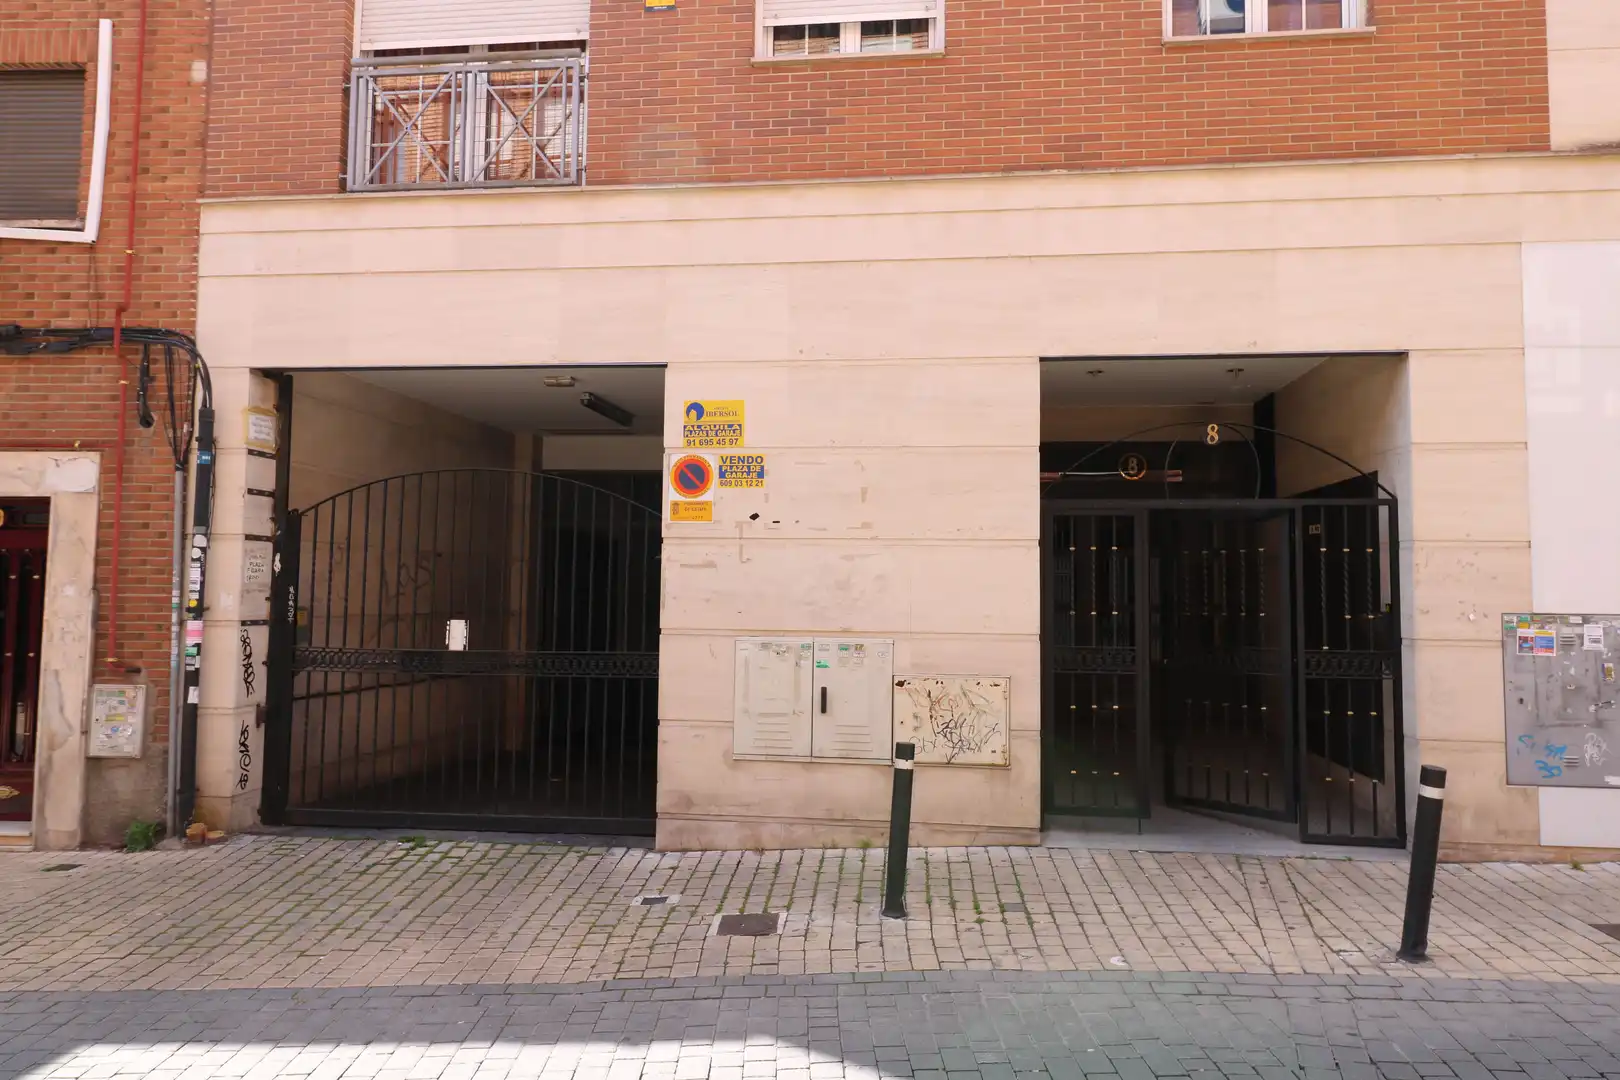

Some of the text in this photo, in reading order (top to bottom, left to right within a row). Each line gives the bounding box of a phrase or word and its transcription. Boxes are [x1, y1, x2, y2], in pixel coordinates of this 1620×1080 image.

[1206, 423, 1219, 445] 8
[686, 438, 739, 447] 91 695 45 97
[720, 455, 764, 465] VENDO
[1127, 457, 1138, 474] 8
